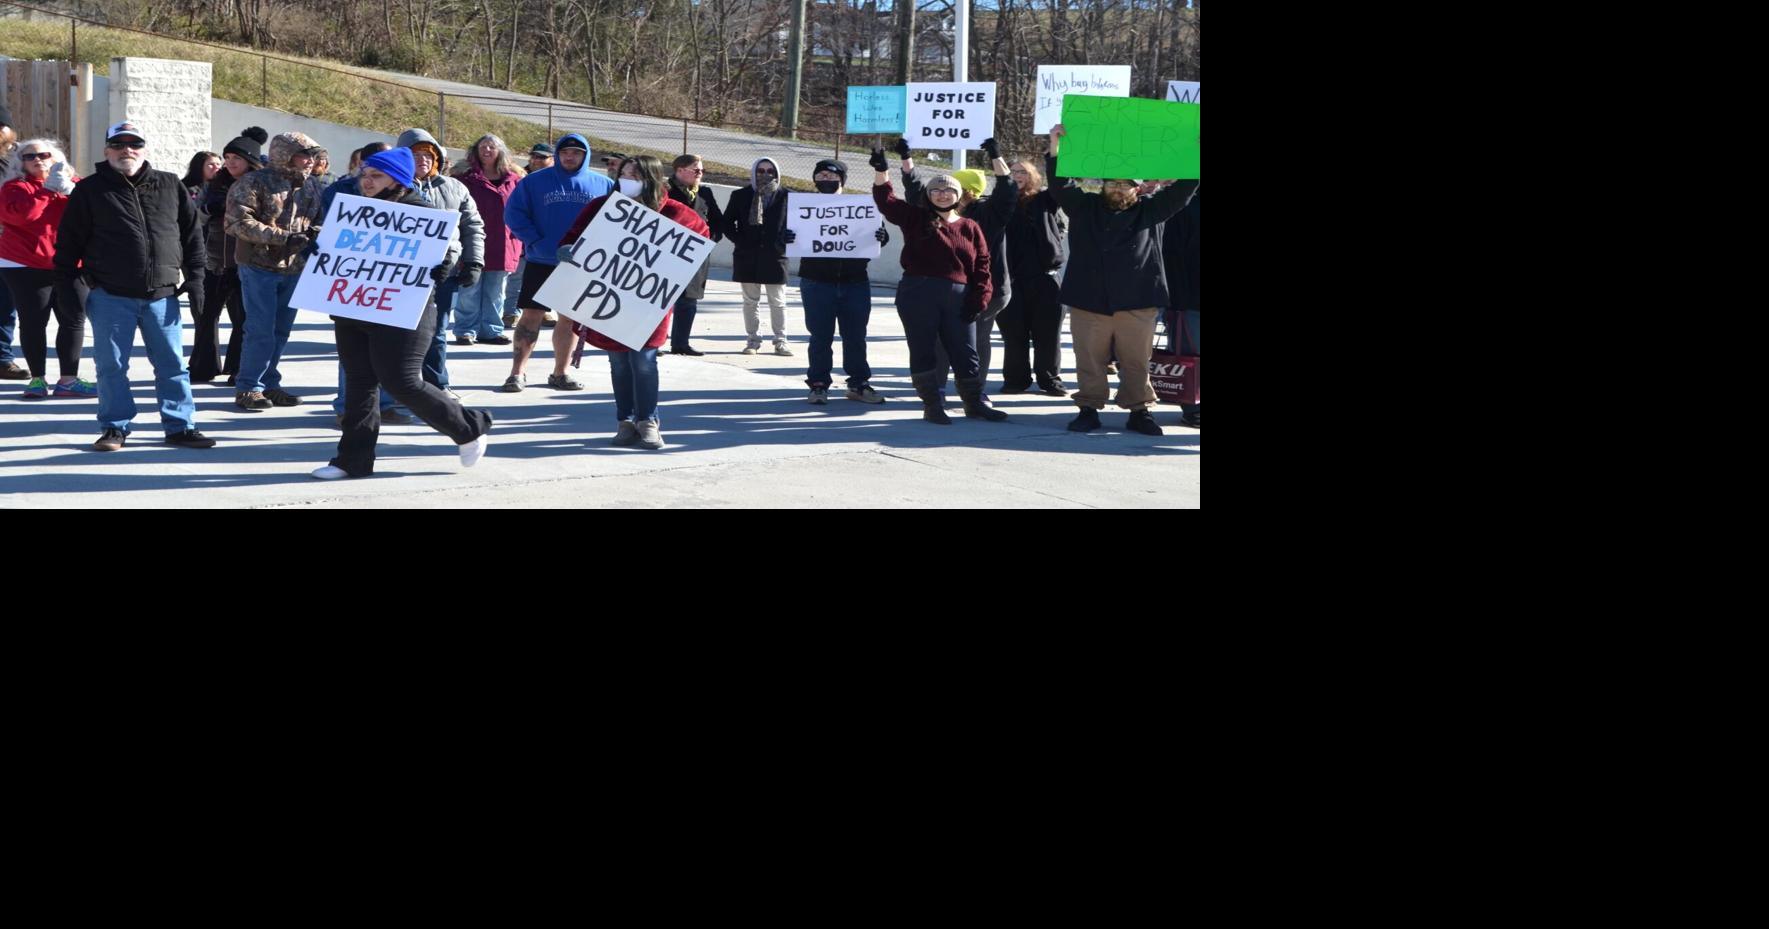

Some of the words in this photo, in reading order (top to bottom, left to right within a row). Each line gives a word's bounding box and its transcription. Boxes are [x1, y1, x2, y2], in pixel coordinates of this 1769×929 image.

[914, 92, 986, 103] JUSTICE
[1041, 71, 1068, 94] Why
[932, 109, 965, 119] FOR
[922, 126, 970, 139] DOUG
[336, 201, 449, 241] WRONGFUL
[799, 205, 875, 219] JUSTICE
[334, 228, 421, 260] DEATH
[604, 199, 705, 263] SHAME
[812, 239, 856, 253] DOUG
[820, 224, 849, 236] FOR
[617, 236, 661, 268] ON
[312, 252, 430, 288] RIGHTFUL
[568, 237, 680, 310] LONDON
[326, 278, 401, 311] RAGE
[572, 280, 621, 320] PD
